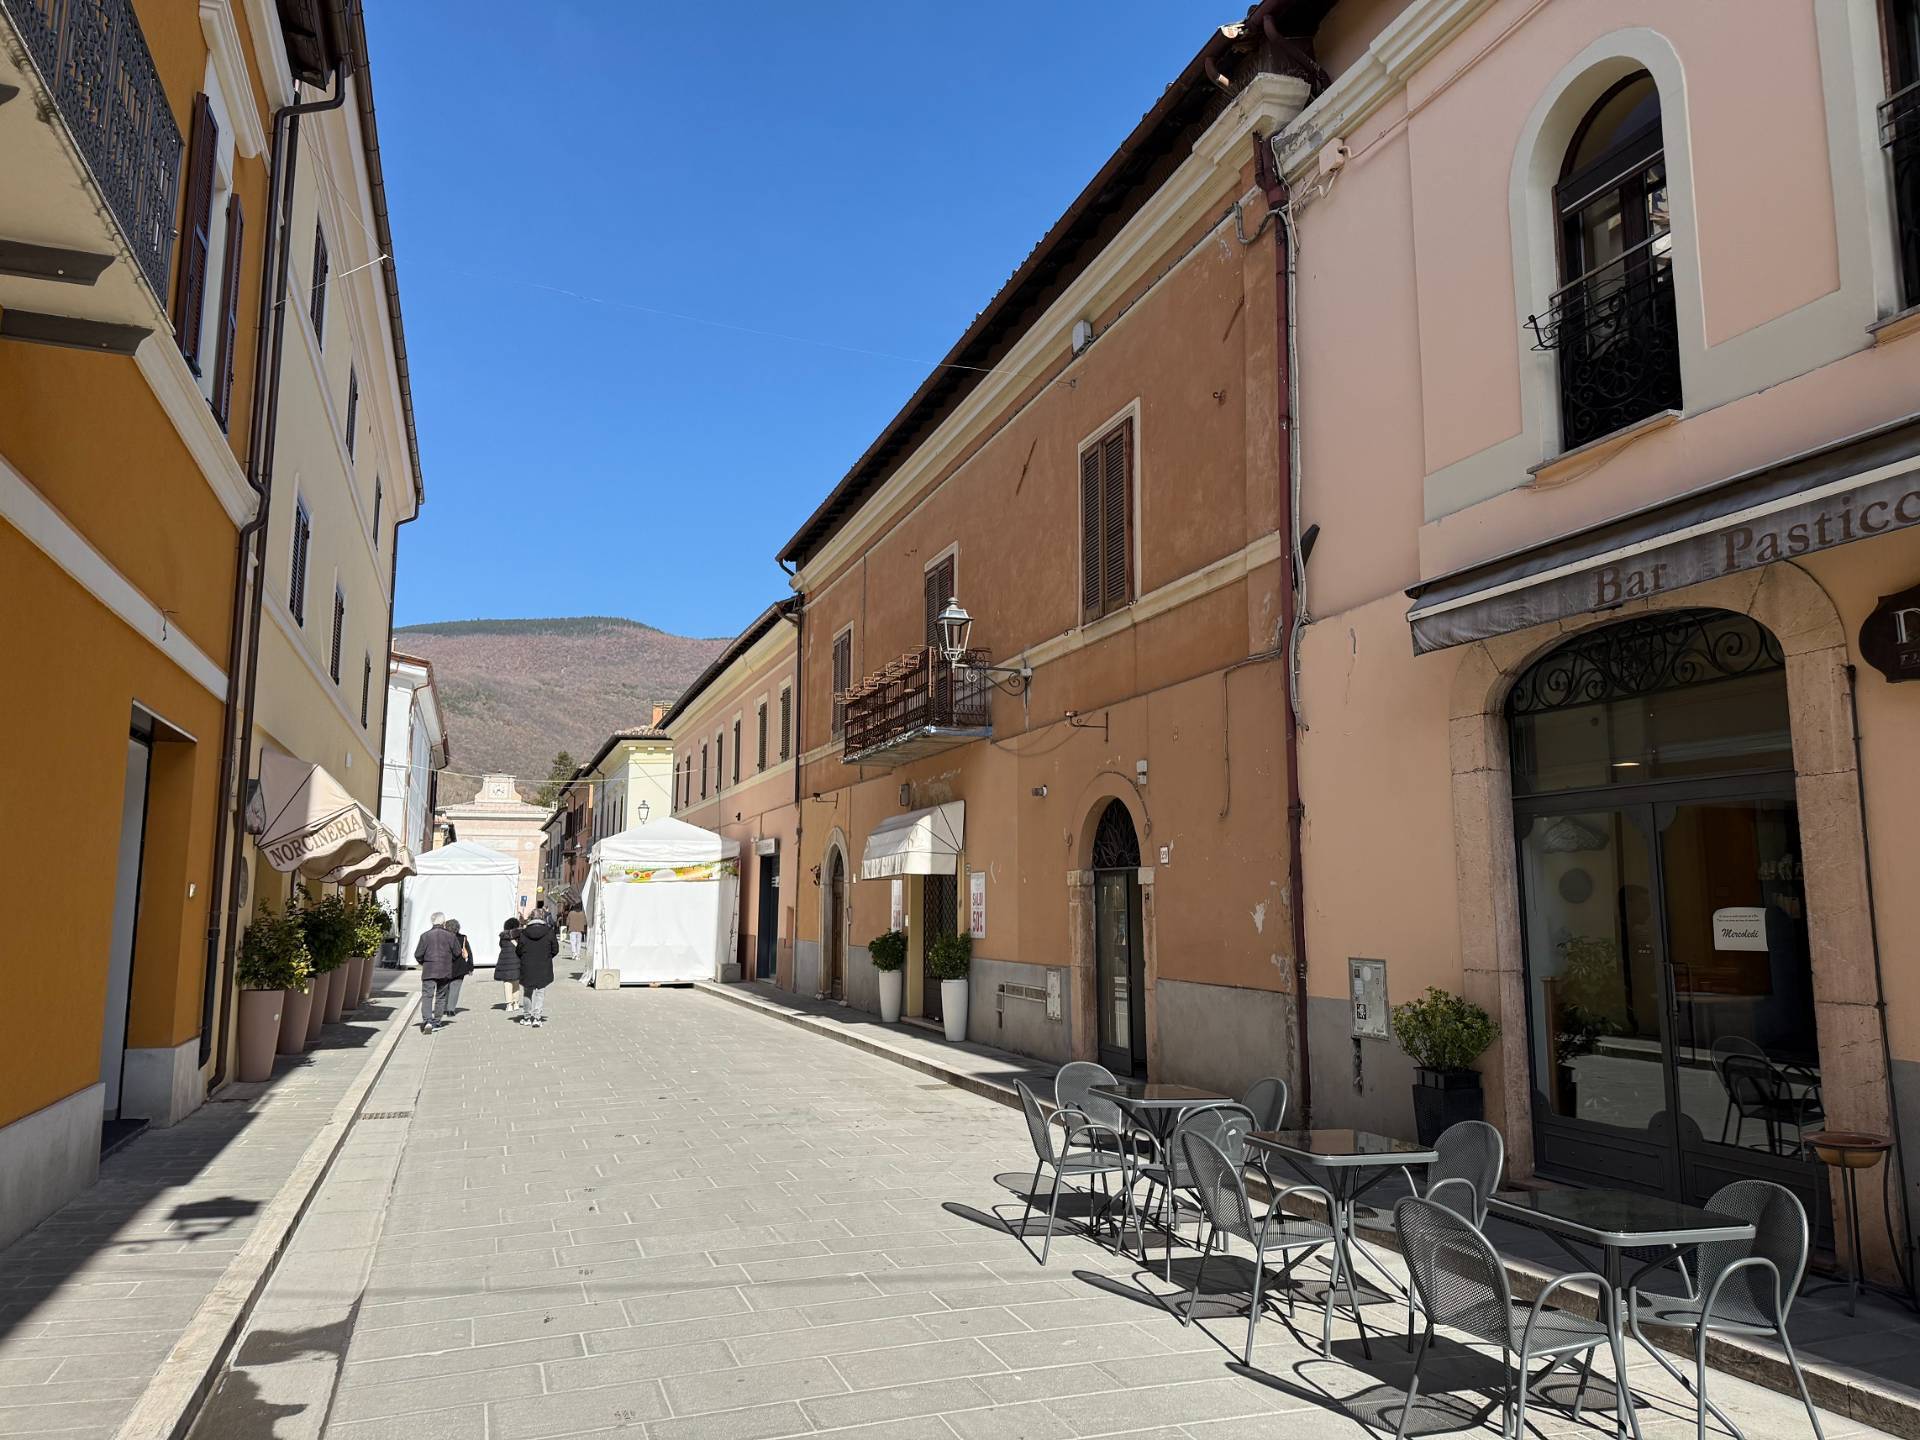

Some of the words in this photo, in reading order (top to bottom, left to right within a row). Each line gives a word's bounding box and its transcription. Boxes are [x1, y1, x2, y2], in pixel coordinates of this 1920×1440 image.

[1593, 563, 1667, 607] Bar
[1720, 490, 1920, 573] Pasticc
[269, 813, 362, 867] NORCINERIA
